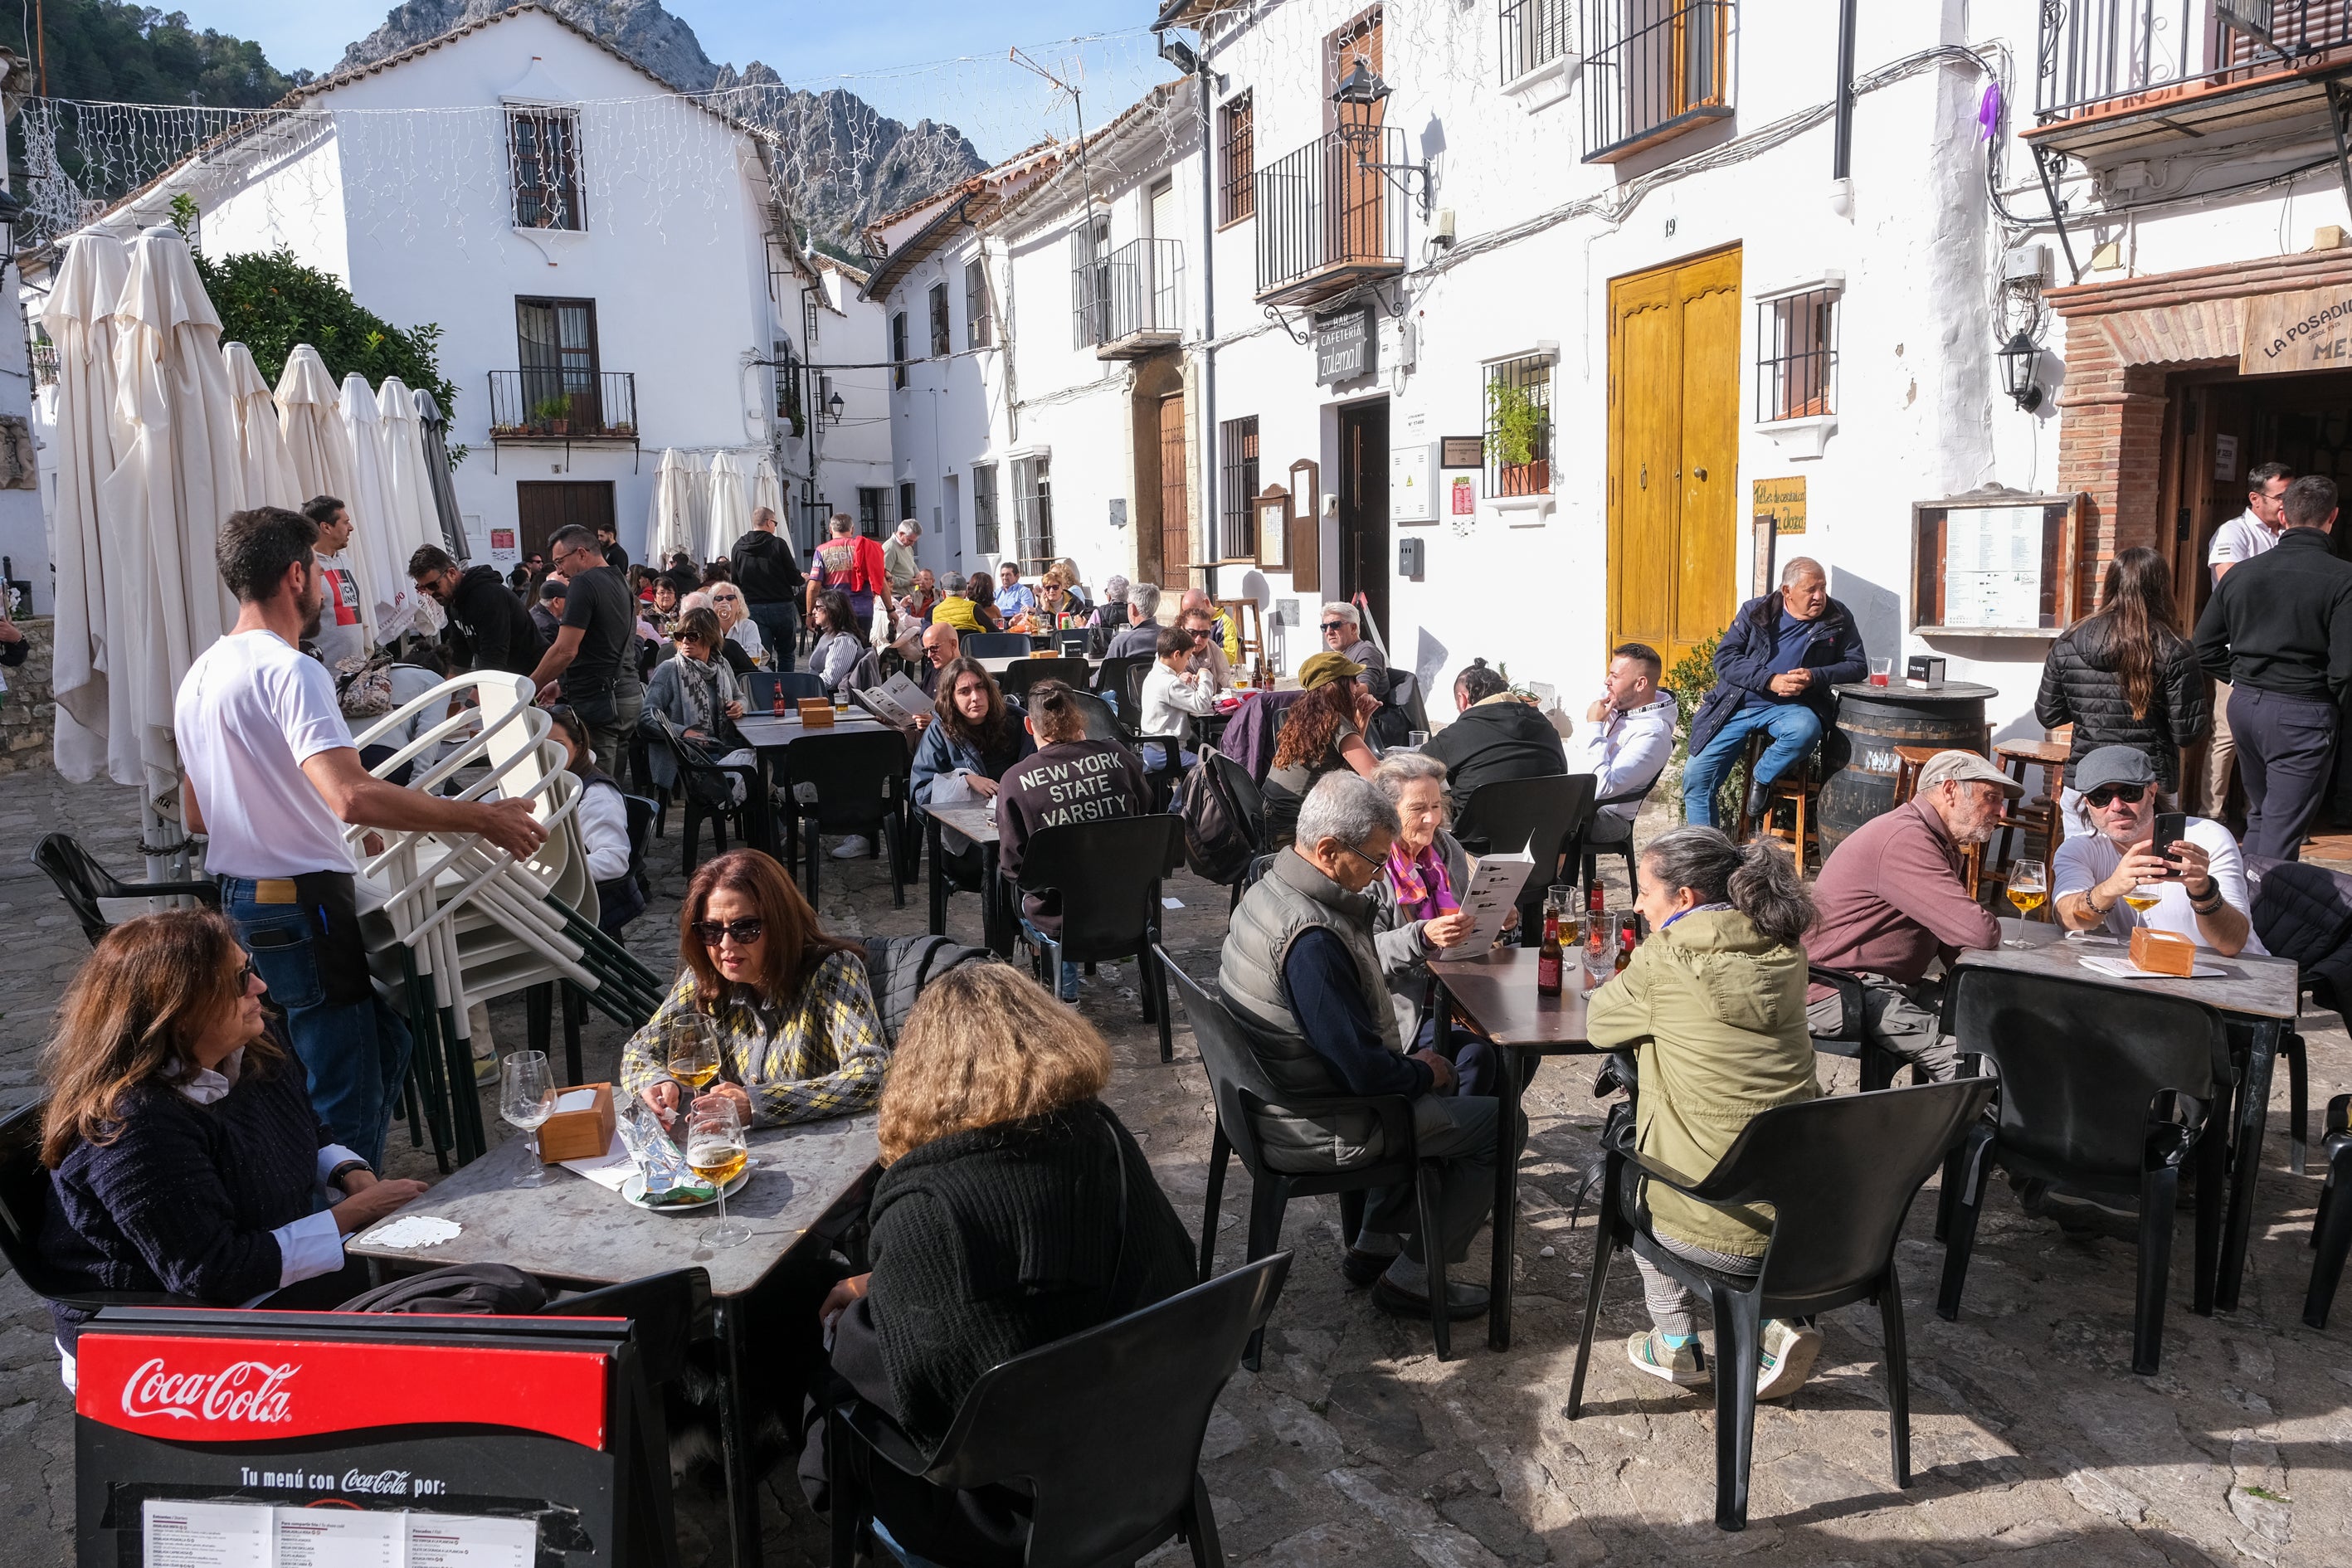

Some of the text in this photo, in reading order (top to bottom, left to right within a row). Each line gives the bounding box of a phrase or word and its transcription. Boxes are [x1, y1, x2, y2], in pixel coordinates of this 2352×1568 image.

[1665, 218, 1676, 238] 19
[1333, 314, 1348, 329] BAR
[2263, 338, 2287, 358] LA
[2311, 337, 2352, 361] ME
[1019, 752, 1124, 791] NEW YORK
[1049, 773, 1112, 803] STATE
[1041, 794, 1127, 826] VARSITY
[121, 1357, 303, 1423] Coca-Cola
[241, 1467, 446, 1497] Tu menú con Coca-Cola por:
